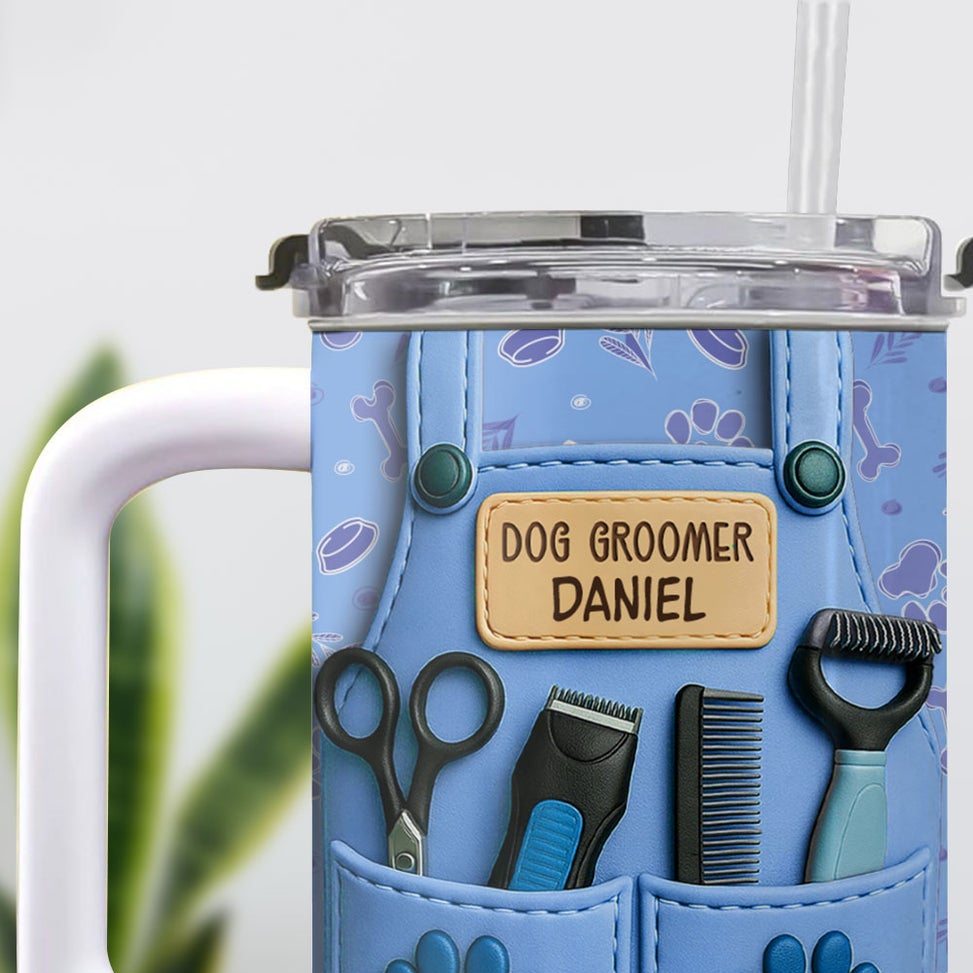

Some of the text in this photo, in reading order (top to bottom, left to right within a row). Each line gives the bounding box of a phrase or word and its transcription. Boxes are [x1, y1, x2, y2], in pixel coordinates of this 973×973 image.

[501, 520, 755, 563] DOG GROOMER
[551, 575, 707, 623] DANIEL
